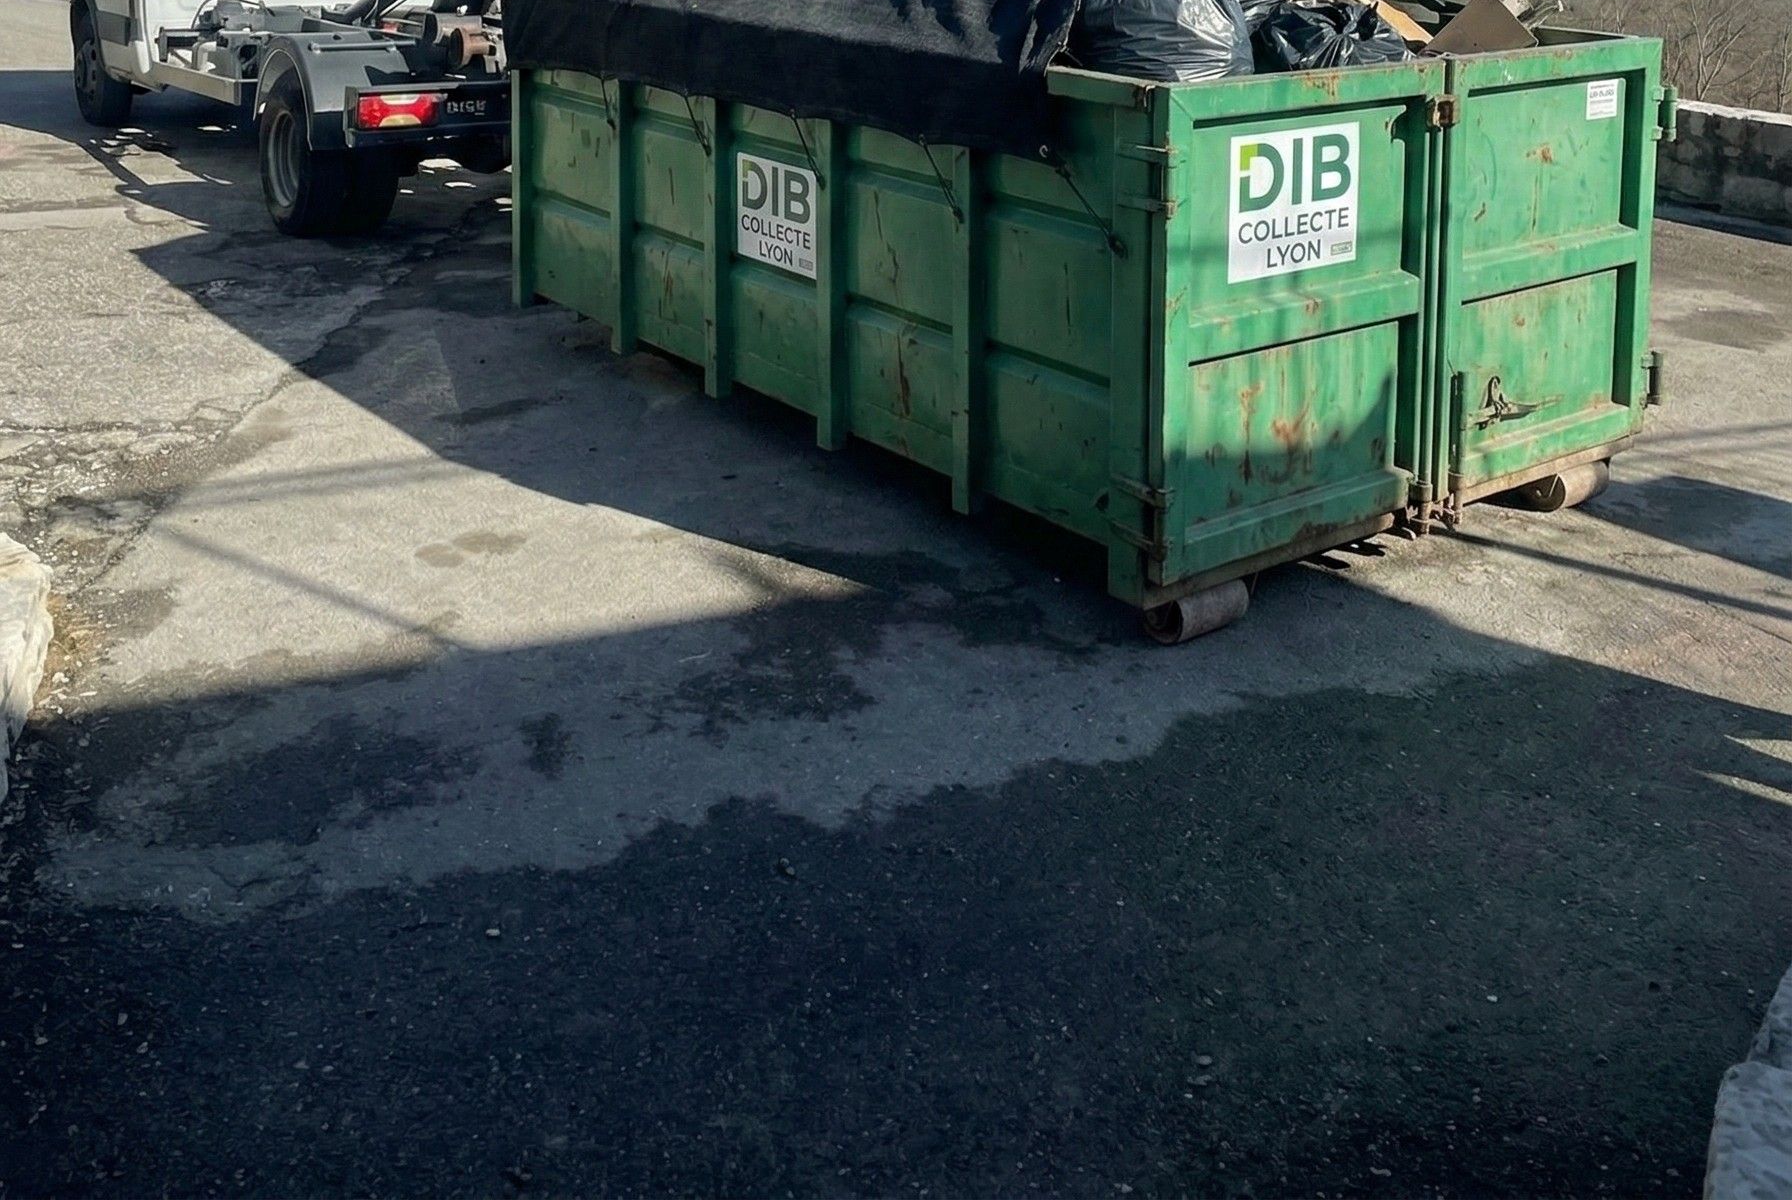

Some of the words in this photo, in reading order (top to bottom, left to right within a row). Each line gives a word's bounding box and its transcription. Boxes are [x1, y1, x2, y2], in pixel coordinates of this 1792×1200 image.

[1238, 133, 1352, 213] DIB
[742, 159, 811, 224] DIB
[741, 214, 811, 250] COLLECTE
[1238, 207, 1350, 244] COLLECTE
[759, 240, 793, 266] LYON
[1266, 239, 1322, 268] LYON
